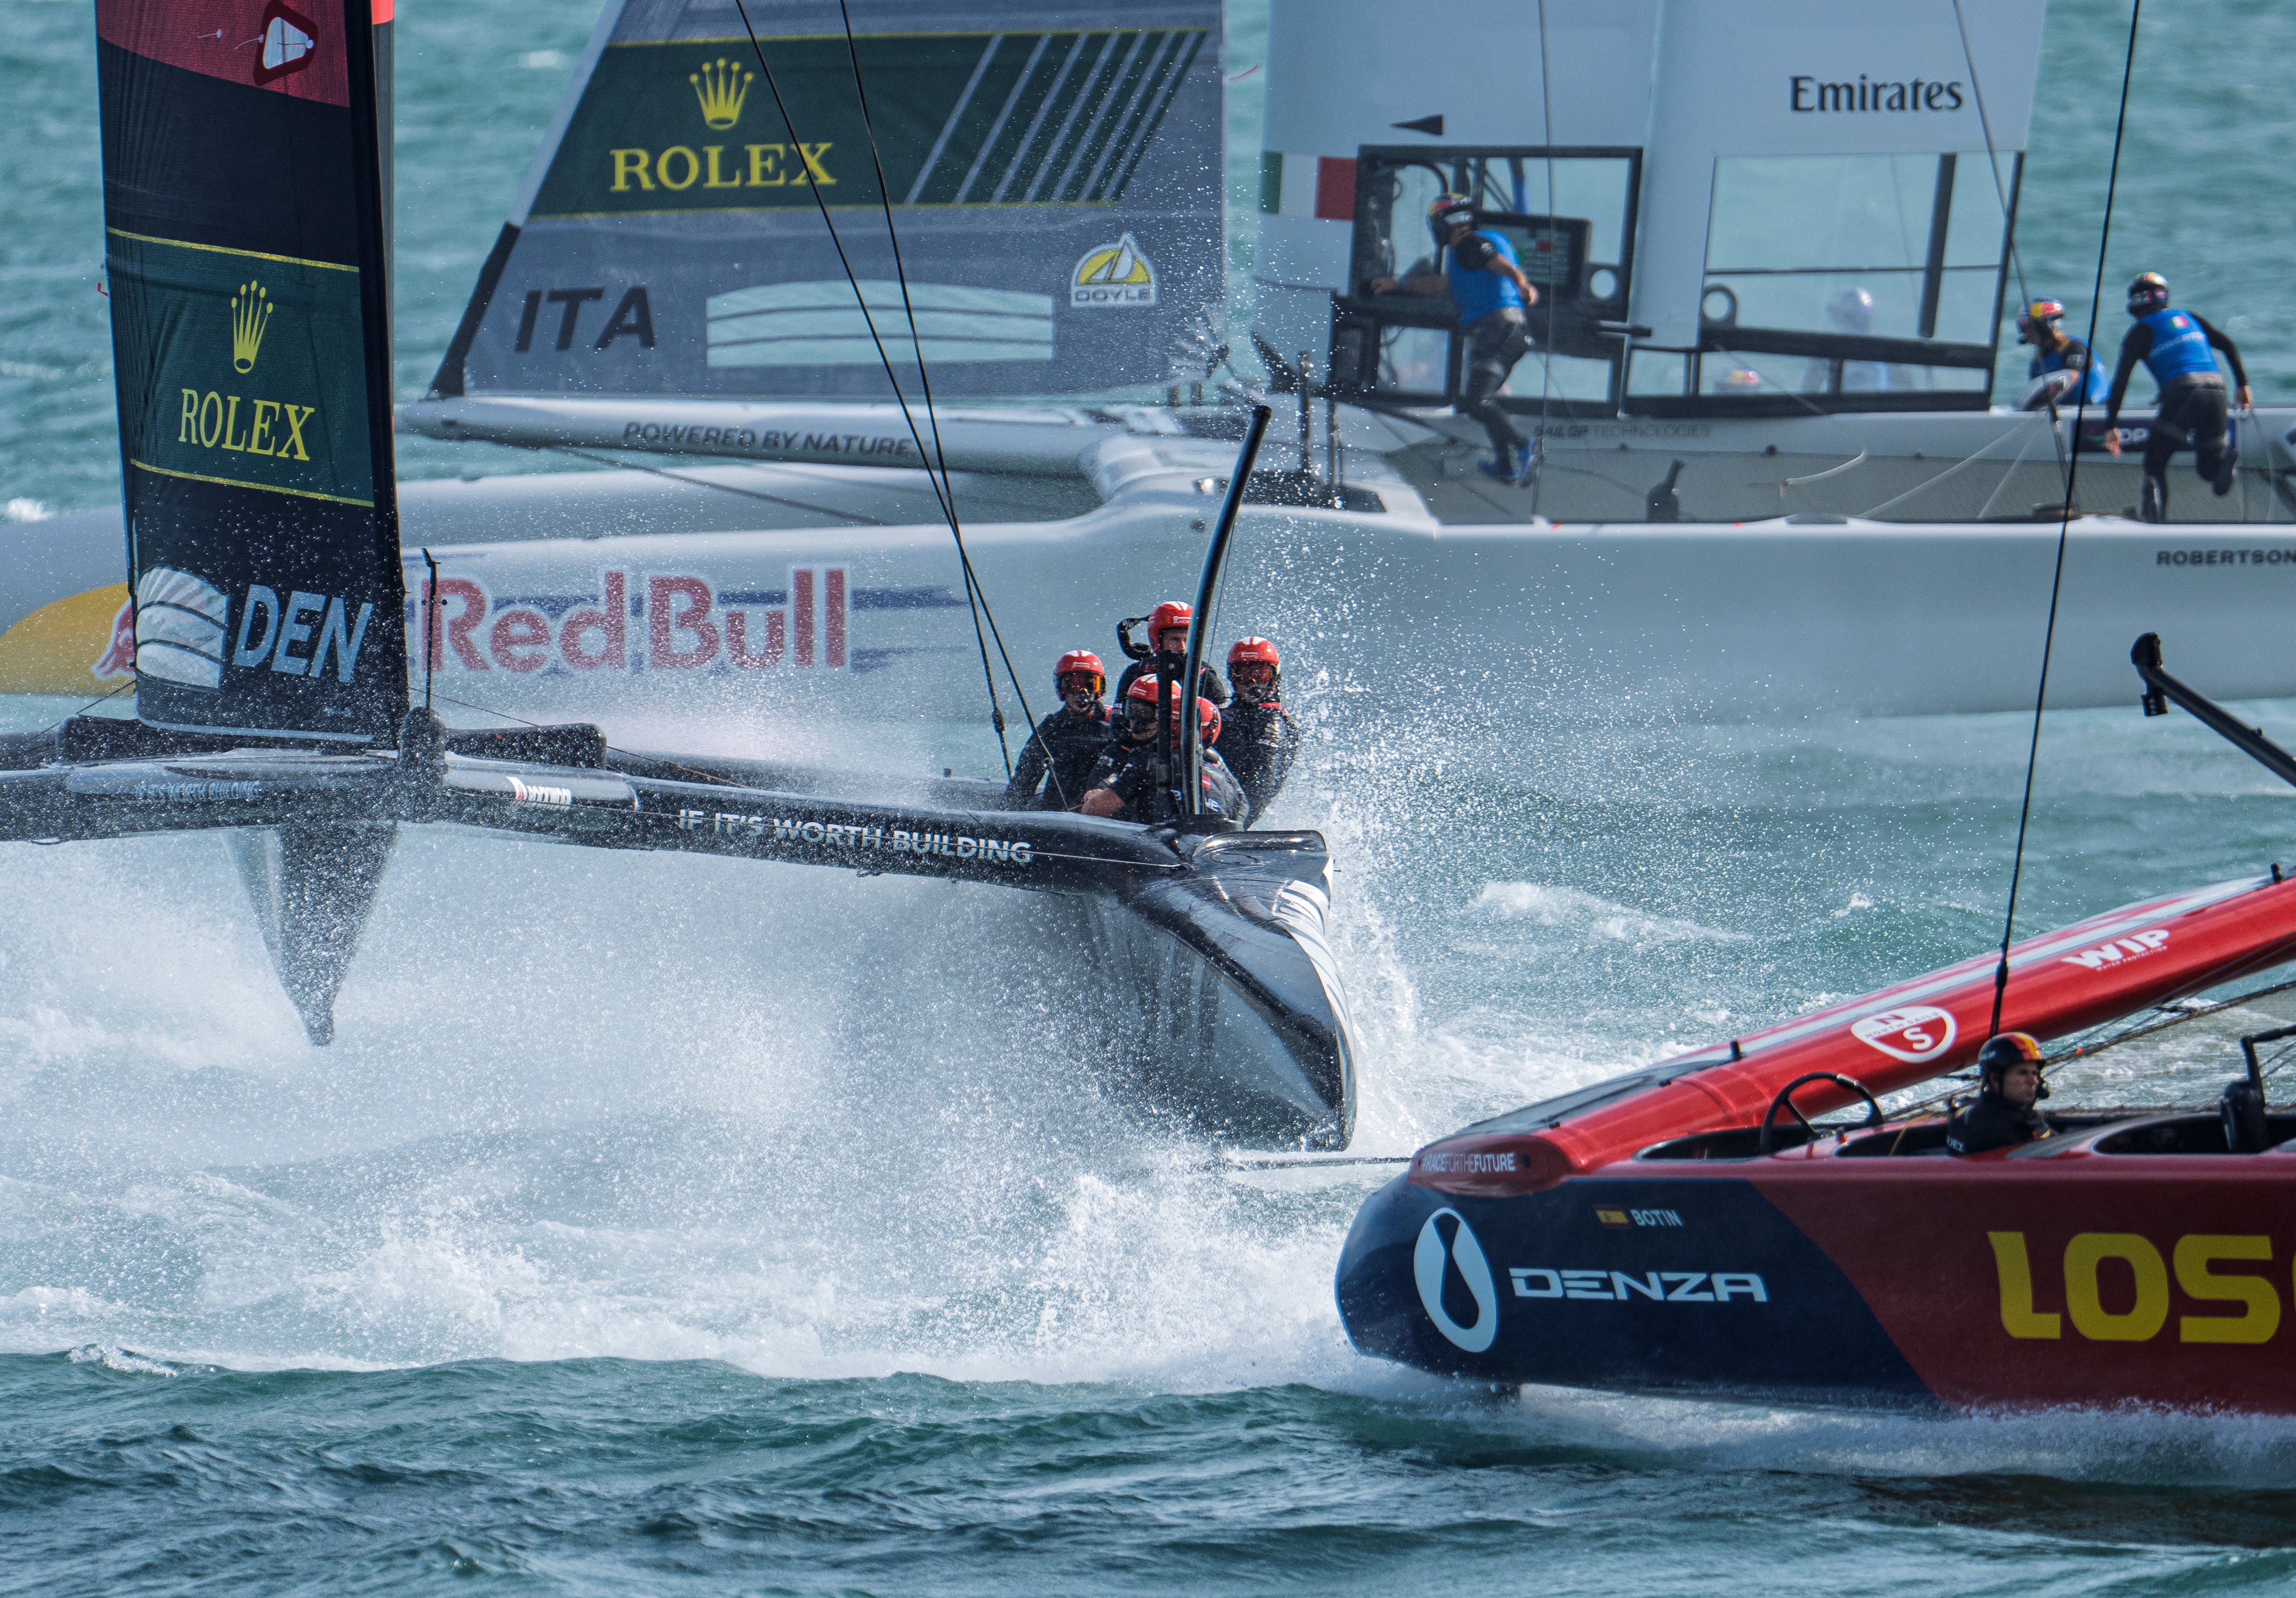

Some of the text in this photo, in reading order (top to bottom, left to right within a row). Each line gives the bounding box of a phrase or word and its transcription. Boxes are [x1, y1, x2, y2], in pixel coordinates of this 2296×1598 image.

[1790, 74, 1964, 113] Emirates
[609, 143, 836, 191] ROLEX
[1077, 290, 1150, 301] DOYLE
[515, 286, 655, 352] ITA
[178, 389, 315, 460] ROLEX
[623, 422, 756, 447] POWERED
[762, 429, 801, 449] BY
[233, 584, 375, 683] DEN
[421, 568, 846, 672] Red Bull
[679, 810, 1031, 862] IF IT'S WORTH BUILDING
[2061, 929, 2169, 968] WIP
[1864, 1012, 1939, 1038] NORTH SAILS
[1903, 1027, 1932, 1050] S
[1630, 1208, 1683, 1226] BOTIN
[1509, 1268, 1768, 1302] DENZA
